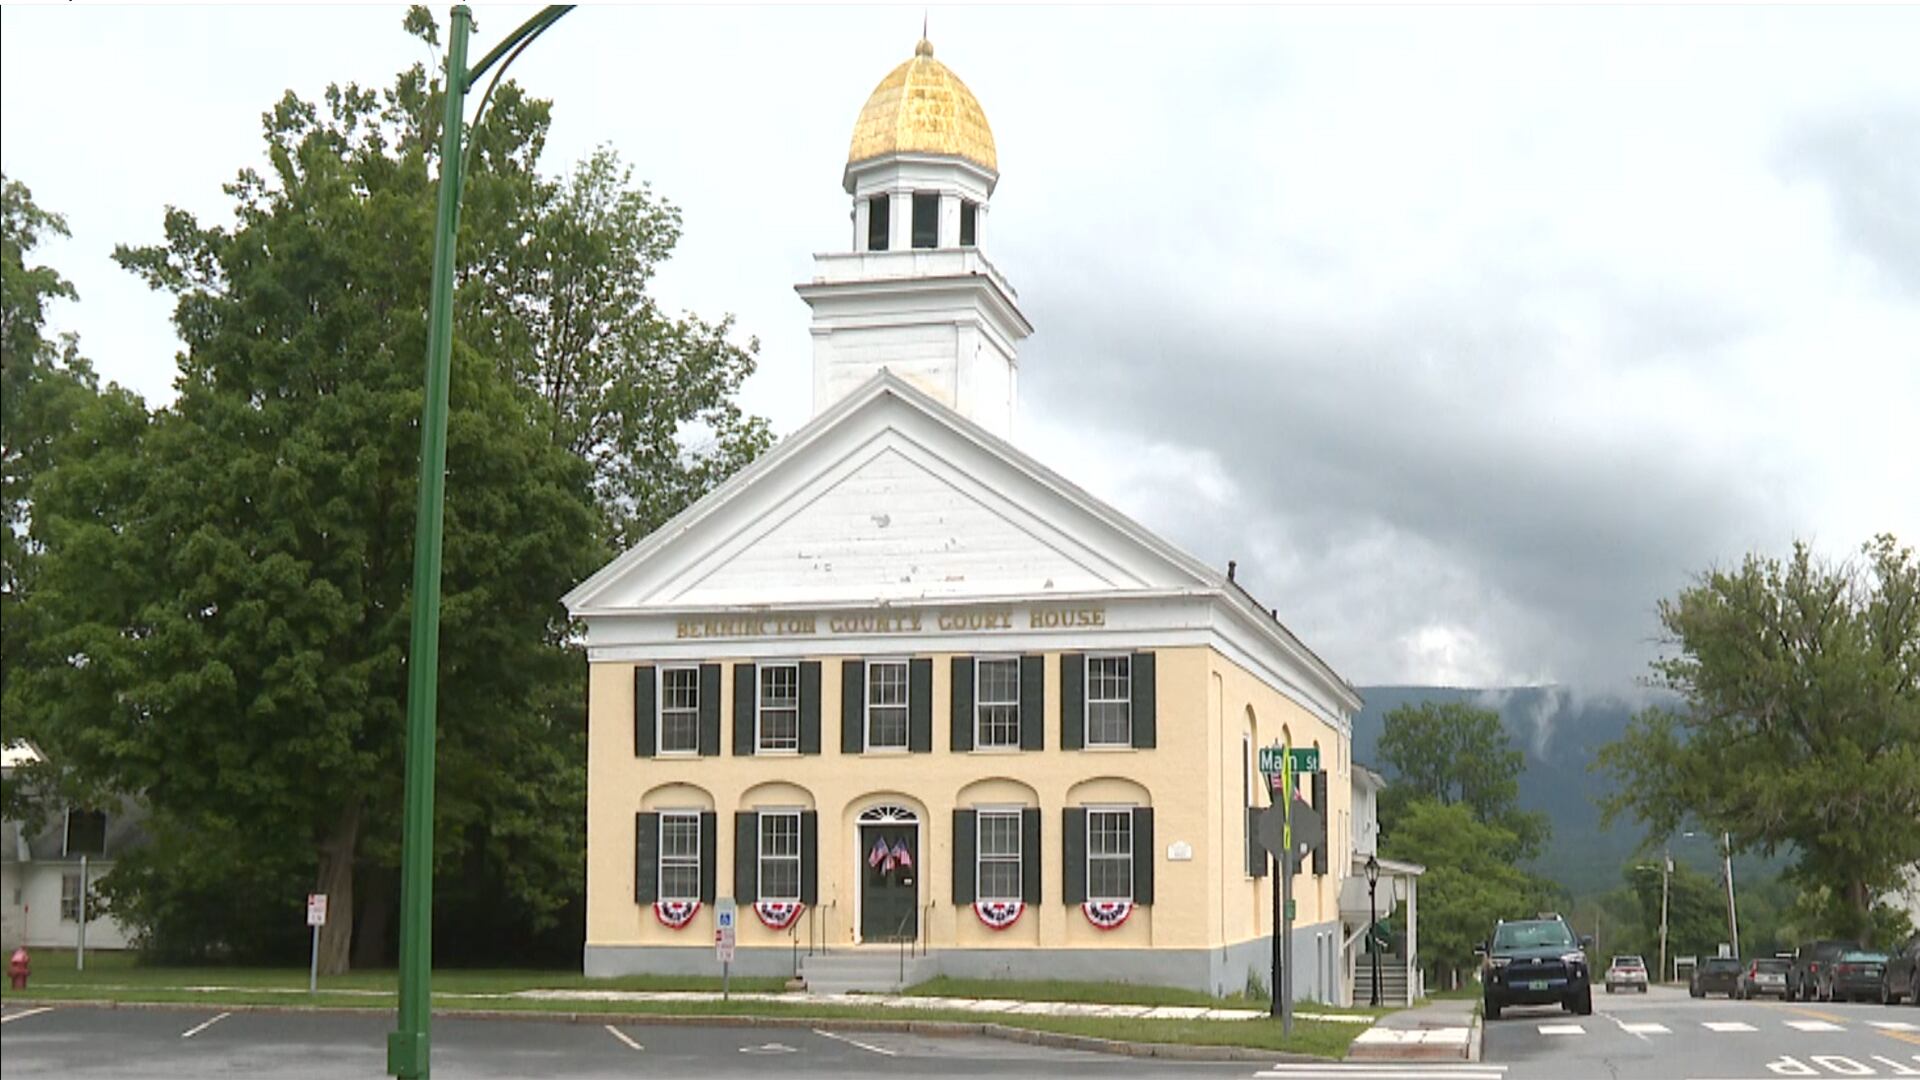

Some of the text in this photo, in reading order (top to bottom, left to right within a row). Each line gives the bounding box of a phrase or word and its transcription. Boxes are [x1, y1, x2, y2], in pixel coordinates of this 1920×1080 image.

[829, 611, 921, 633] COUNTY
[937, 609, 1012, 631] COURT
[1030, 607, 1105, 629] HOUSE
[1261, 750, 1317, 770] Man St
[1766, 1055, 1920, 1075] TOP
